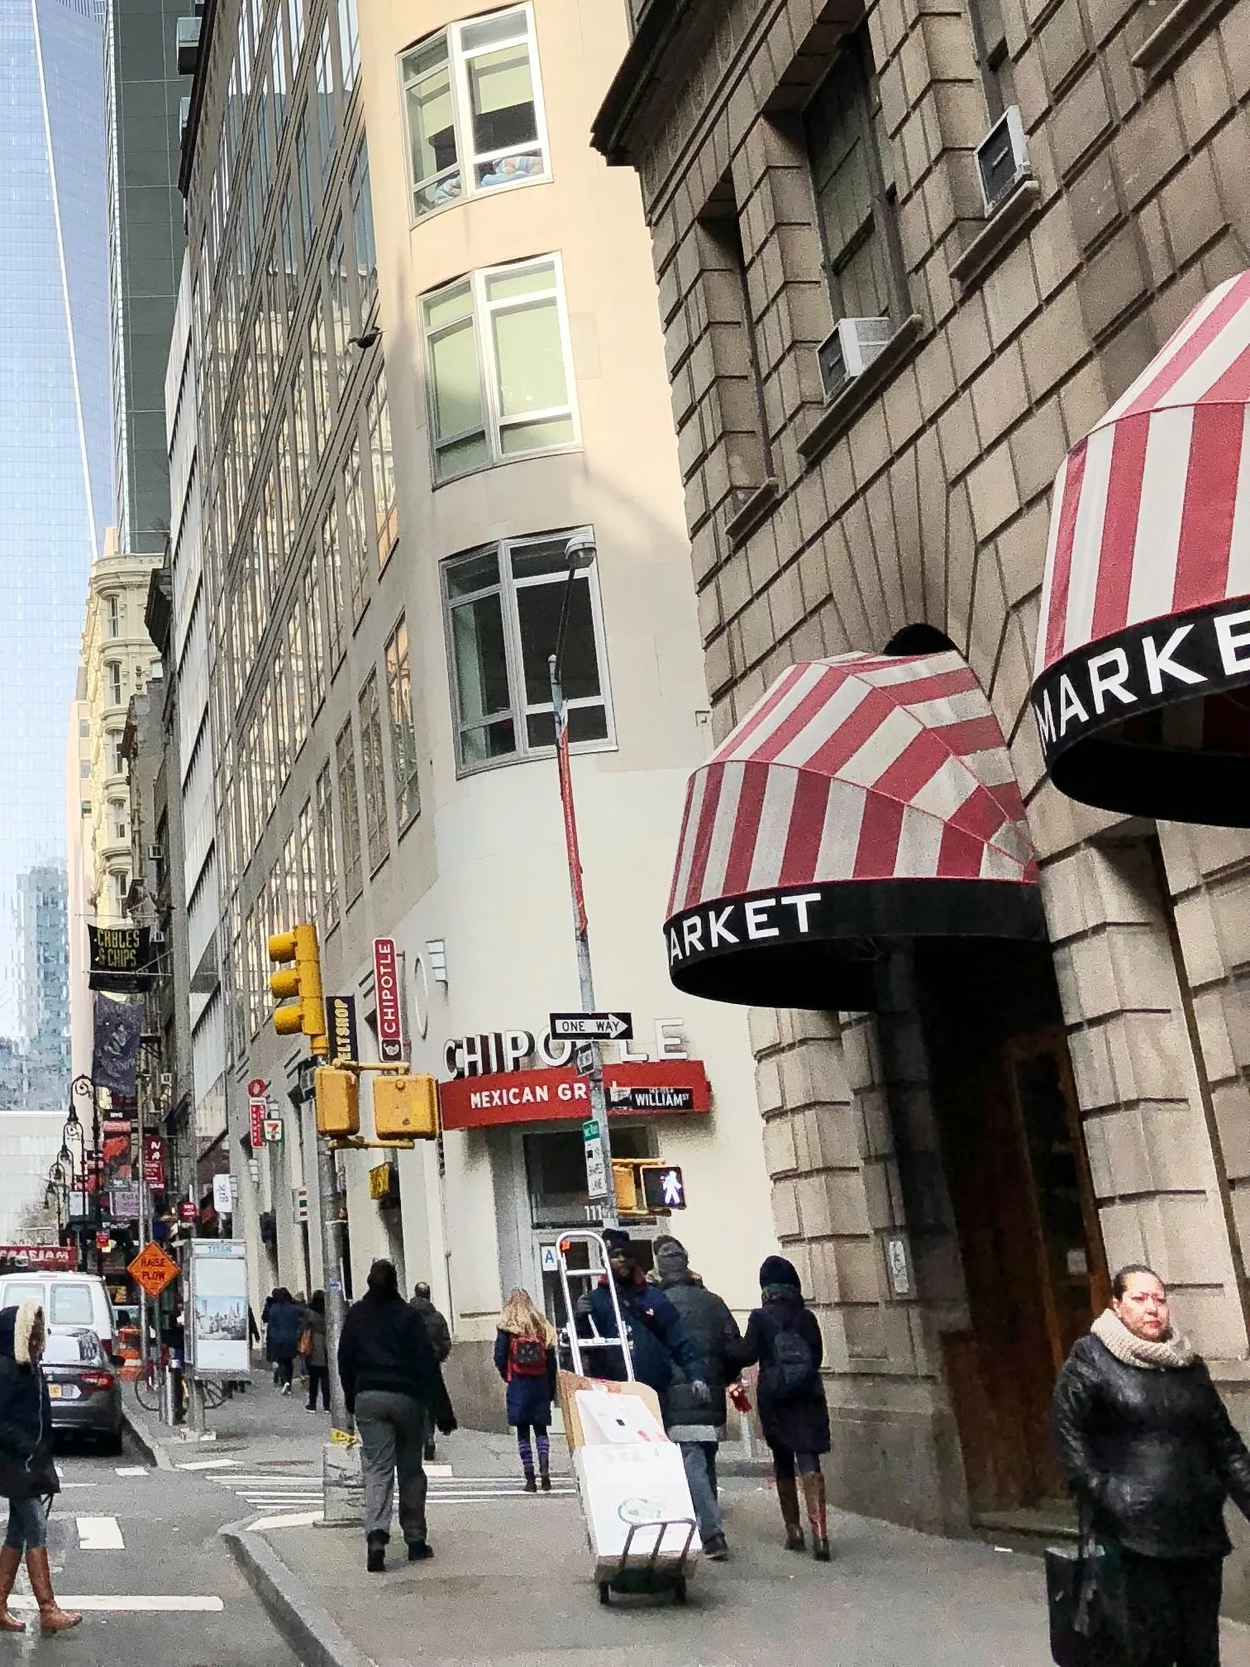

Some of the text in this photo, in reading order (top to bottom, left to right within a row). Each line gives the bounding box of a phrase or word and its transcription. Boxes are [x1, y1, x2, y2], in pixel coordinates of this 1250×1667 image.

[664, 892, 822, 966] ARKET
[107, 948, 138, 967] CHIPS
[378, 942, 397, 1034] CHIPOTLE
[561, 1020, 620, 1032] ONE WAY
[442, 1017, 689, 1080] CHIPOLE
[470, 1084, 549, 1110] MEXICAN
[635, 1093, 683, 1107] WILLIAM
[545, 1248, 555, 1264] A
[141, 1270, 166, 1281] PLOW
